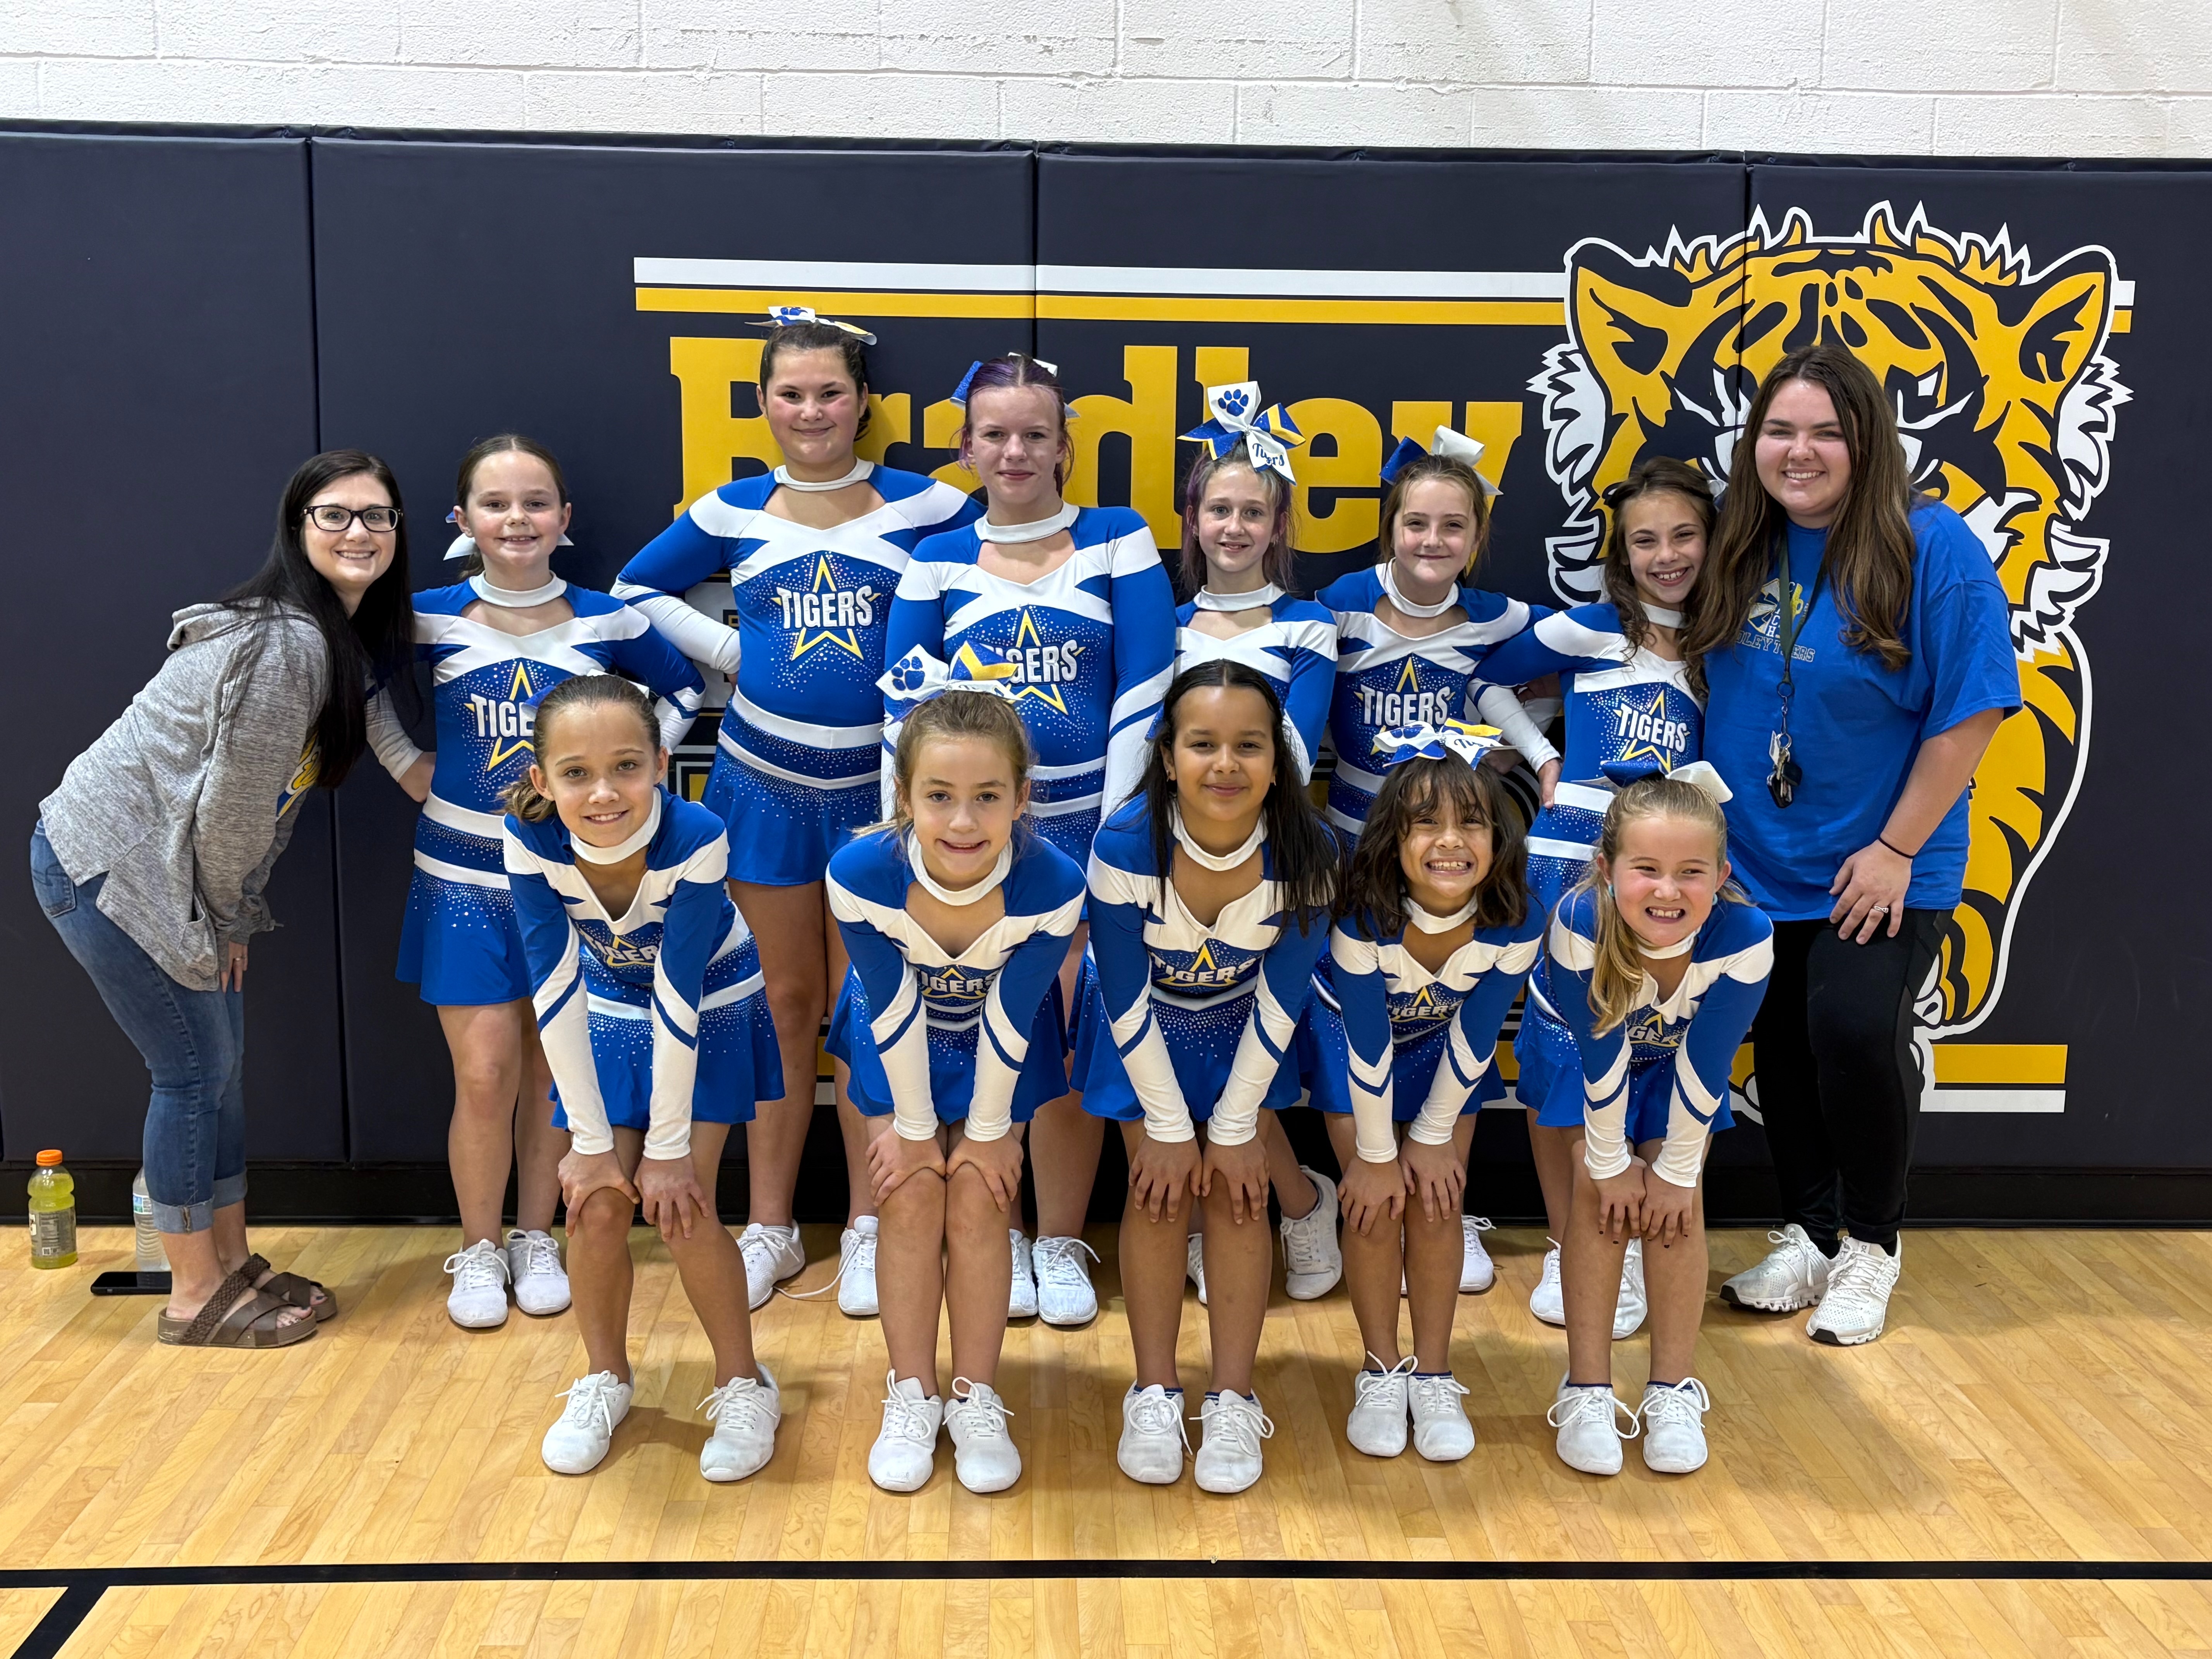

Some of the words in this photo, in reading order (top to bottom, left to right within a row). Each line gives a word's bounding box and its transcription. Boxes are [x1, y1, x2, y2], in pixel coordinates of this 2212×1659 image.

[670, 337, 1523, 576] Brdey
[1252, 443, 1285, 466] Tiers
[776, 585, 872, 629] TIGERS
[979, 639, 1077, 684] GERS
[1735, 630, 1774, 651] DLEY
[1773, 640, 1815, 662] TERS
[471, 693, 536, 737] TIGE
[1360, 684, 1450, 726] TIGERS
[1618, 703, 1687, 752] TIGERS
[579, 928, 659, 961] TIGER
[916, 967, 1000, 993] IGERS
[1149, 951, 1257, 982] TIGERS
[1387, 1003, 1457, 1017] IGER
[1627, 1025, 1681, 1043] GER
